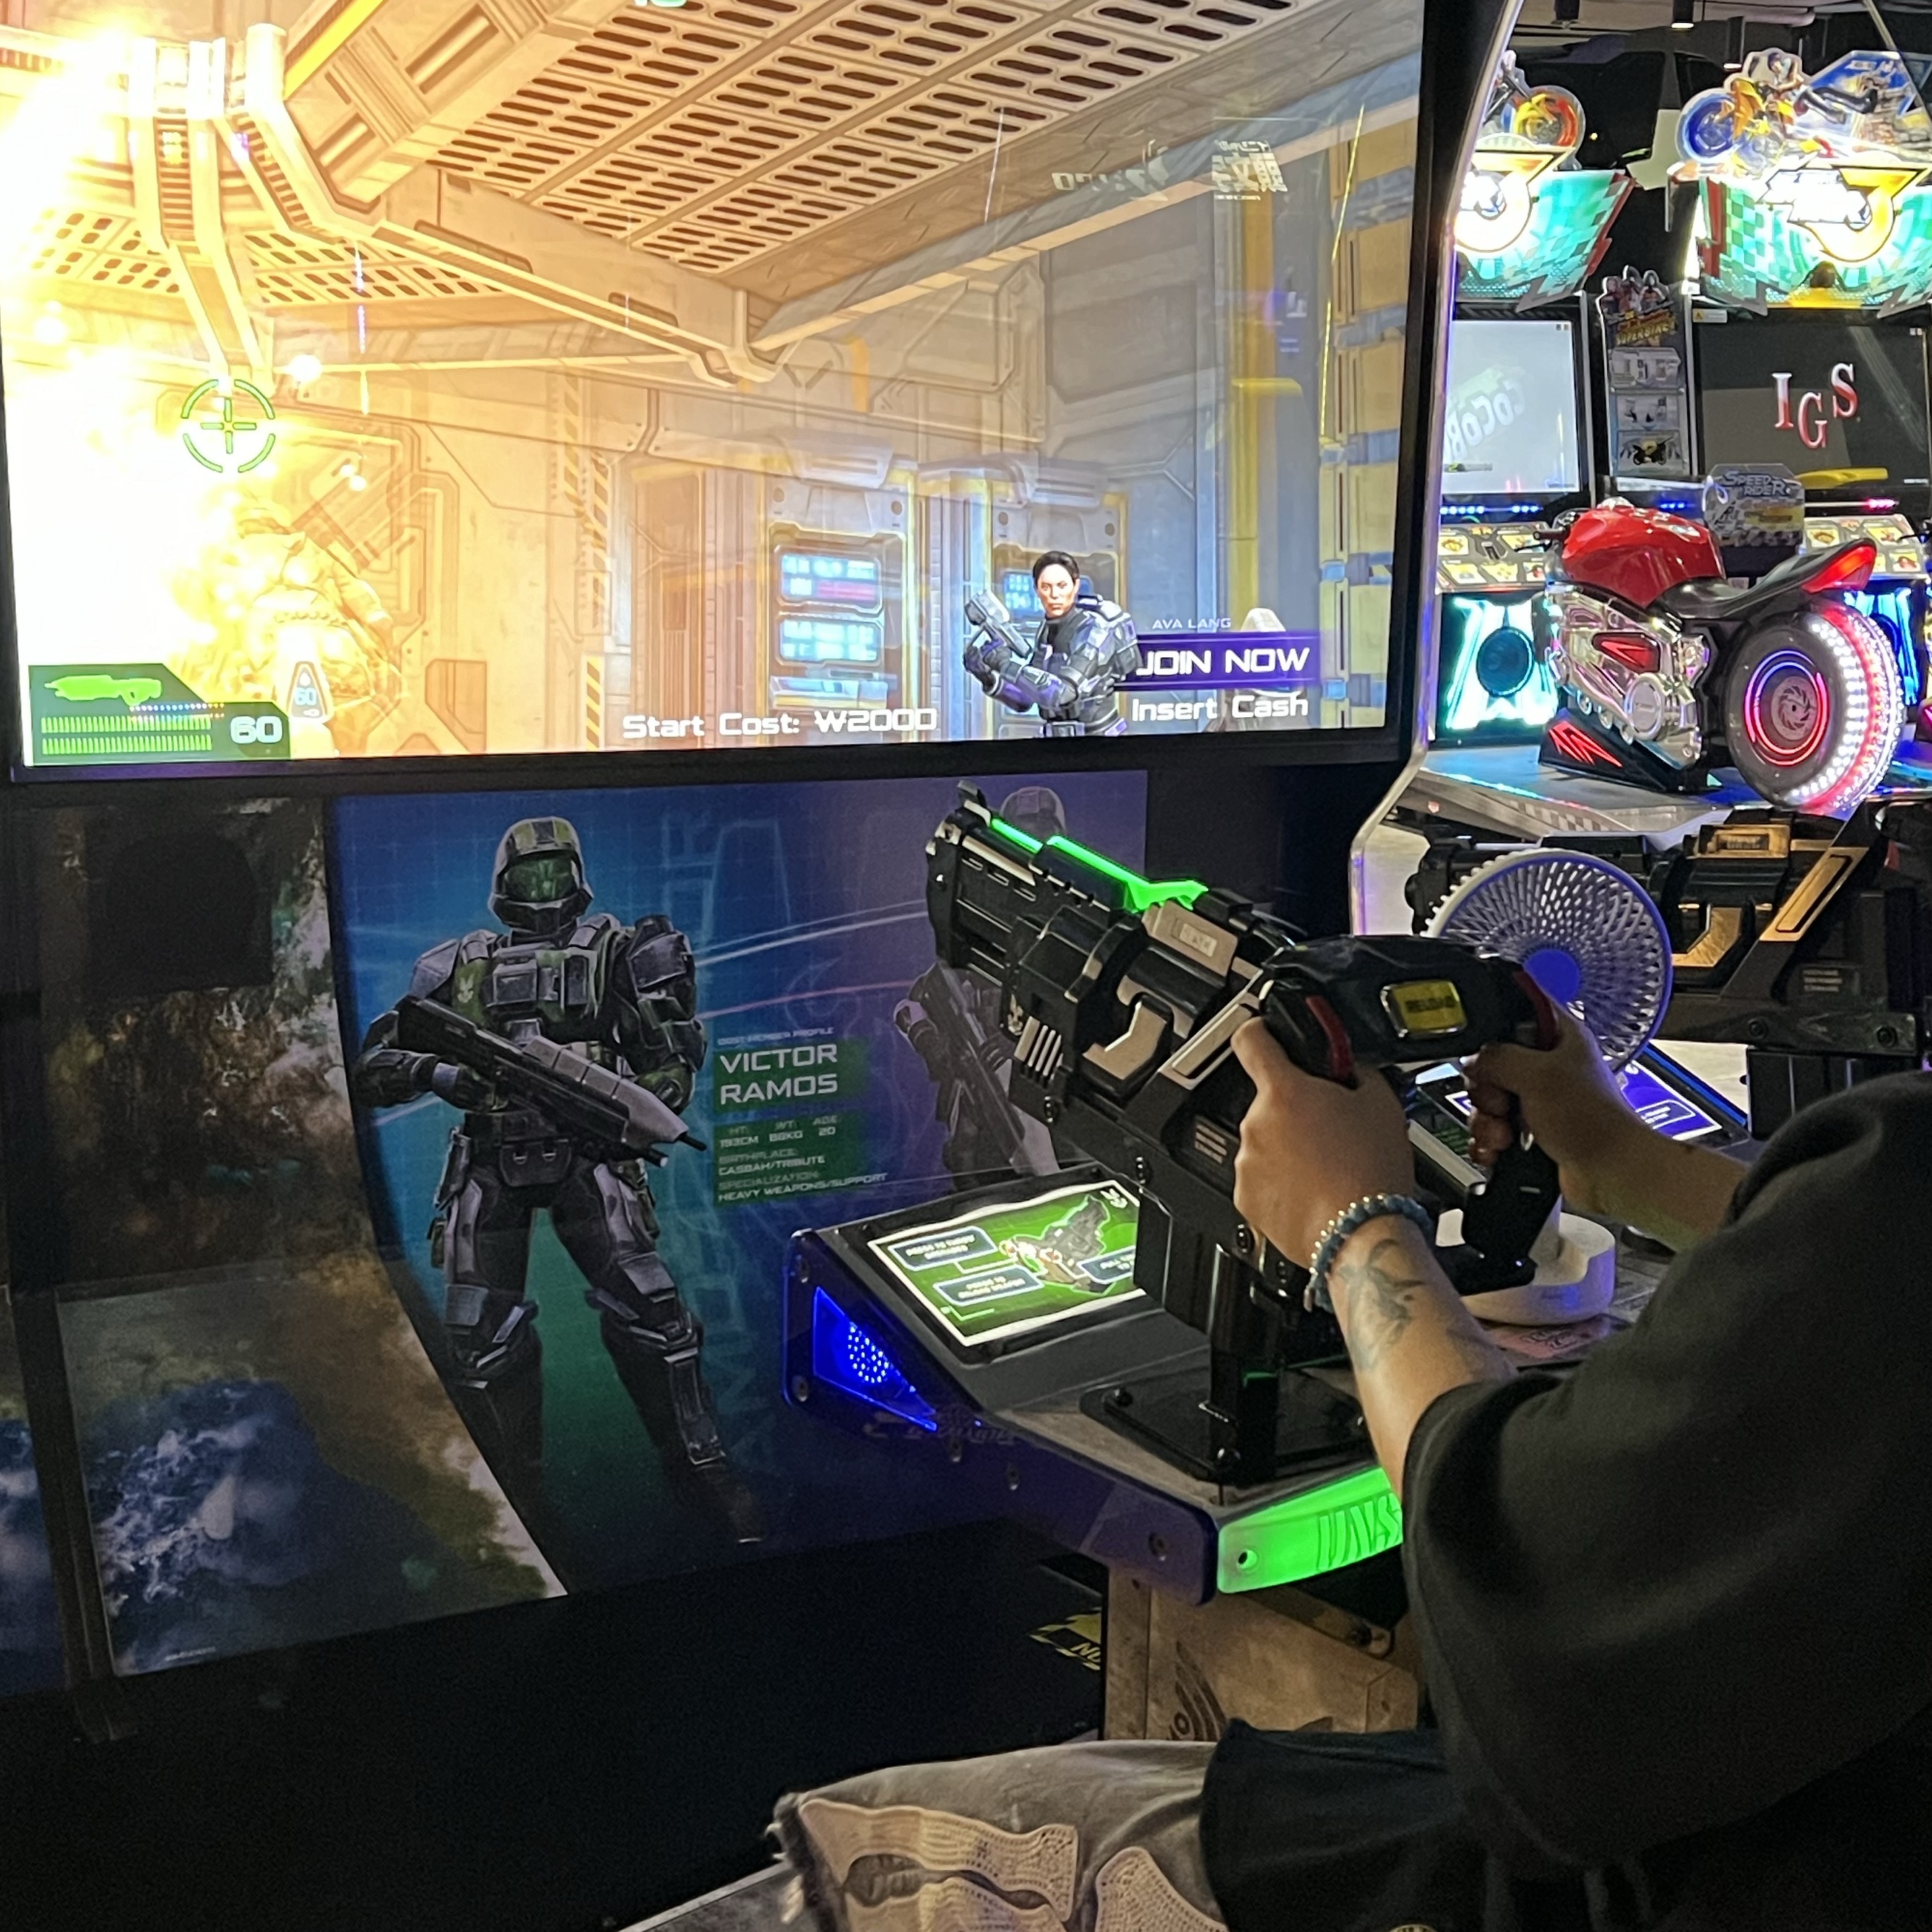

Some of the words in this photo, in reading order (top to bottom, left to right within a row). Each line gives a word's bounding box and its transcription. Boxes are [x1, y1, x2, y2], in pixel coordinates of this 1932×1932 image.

[1772, 363, 1859, 449] IGS
[1723, 470, 1772, 486] SPEED
[1743, 480, 1788, 496] RIDER
[1152, 619, 1182, 629] AVA
[1188, 618, 1231, 628] LANG
[1135, 649, 1212, 675] JOIN
[1225, 646, 1310, 674] NOW
[1132, 697, 1218, 722] Insert
[1231, 694, 1309, 718] Cash
[230, 715, 283, 744] 60
[623, 714, 705, 739] Start
[718, 712, 800, 736] Cost:
[719, 1044, 838, 1073] VICTOR
[720, 1073, 838, 1105] RAMOS
[718, 1189, 760, 1203] HEAVY
